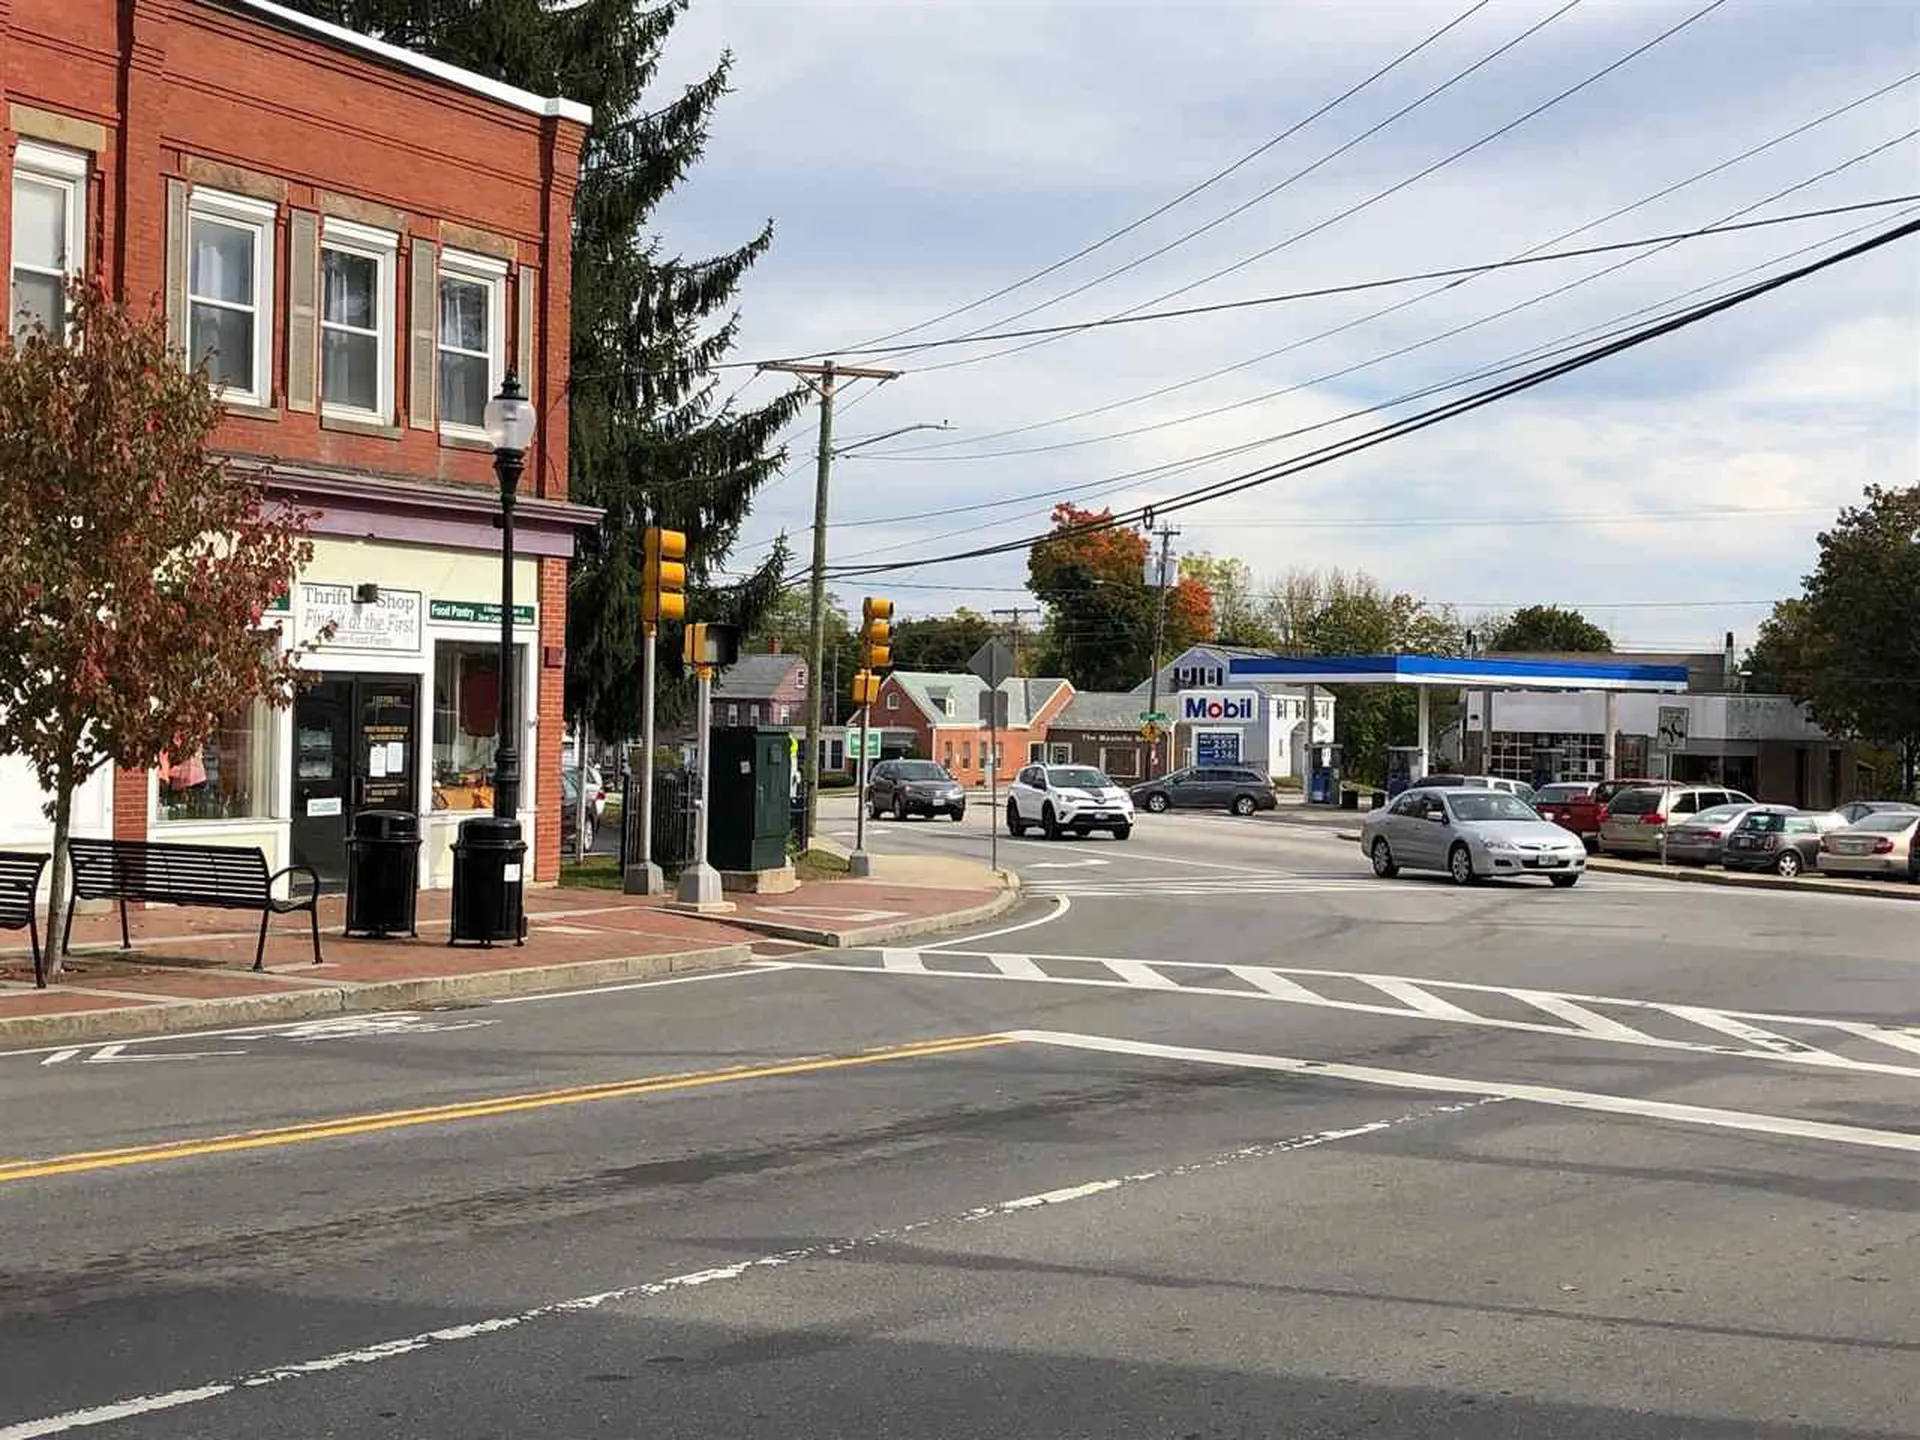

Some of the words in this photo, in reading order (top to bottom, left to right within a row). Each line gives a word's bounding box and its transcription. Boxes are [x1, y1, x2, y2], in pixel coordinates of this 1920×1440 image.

[302, 586, 349, 605] Thrift
[376, 592, 415, 614] Shop
[431, 603, 451, 616] Food
[451, 605, 475, 621] Pantry
[386, 612, 415, 634] First
[1186, 697, 1252, 718] Mobil
